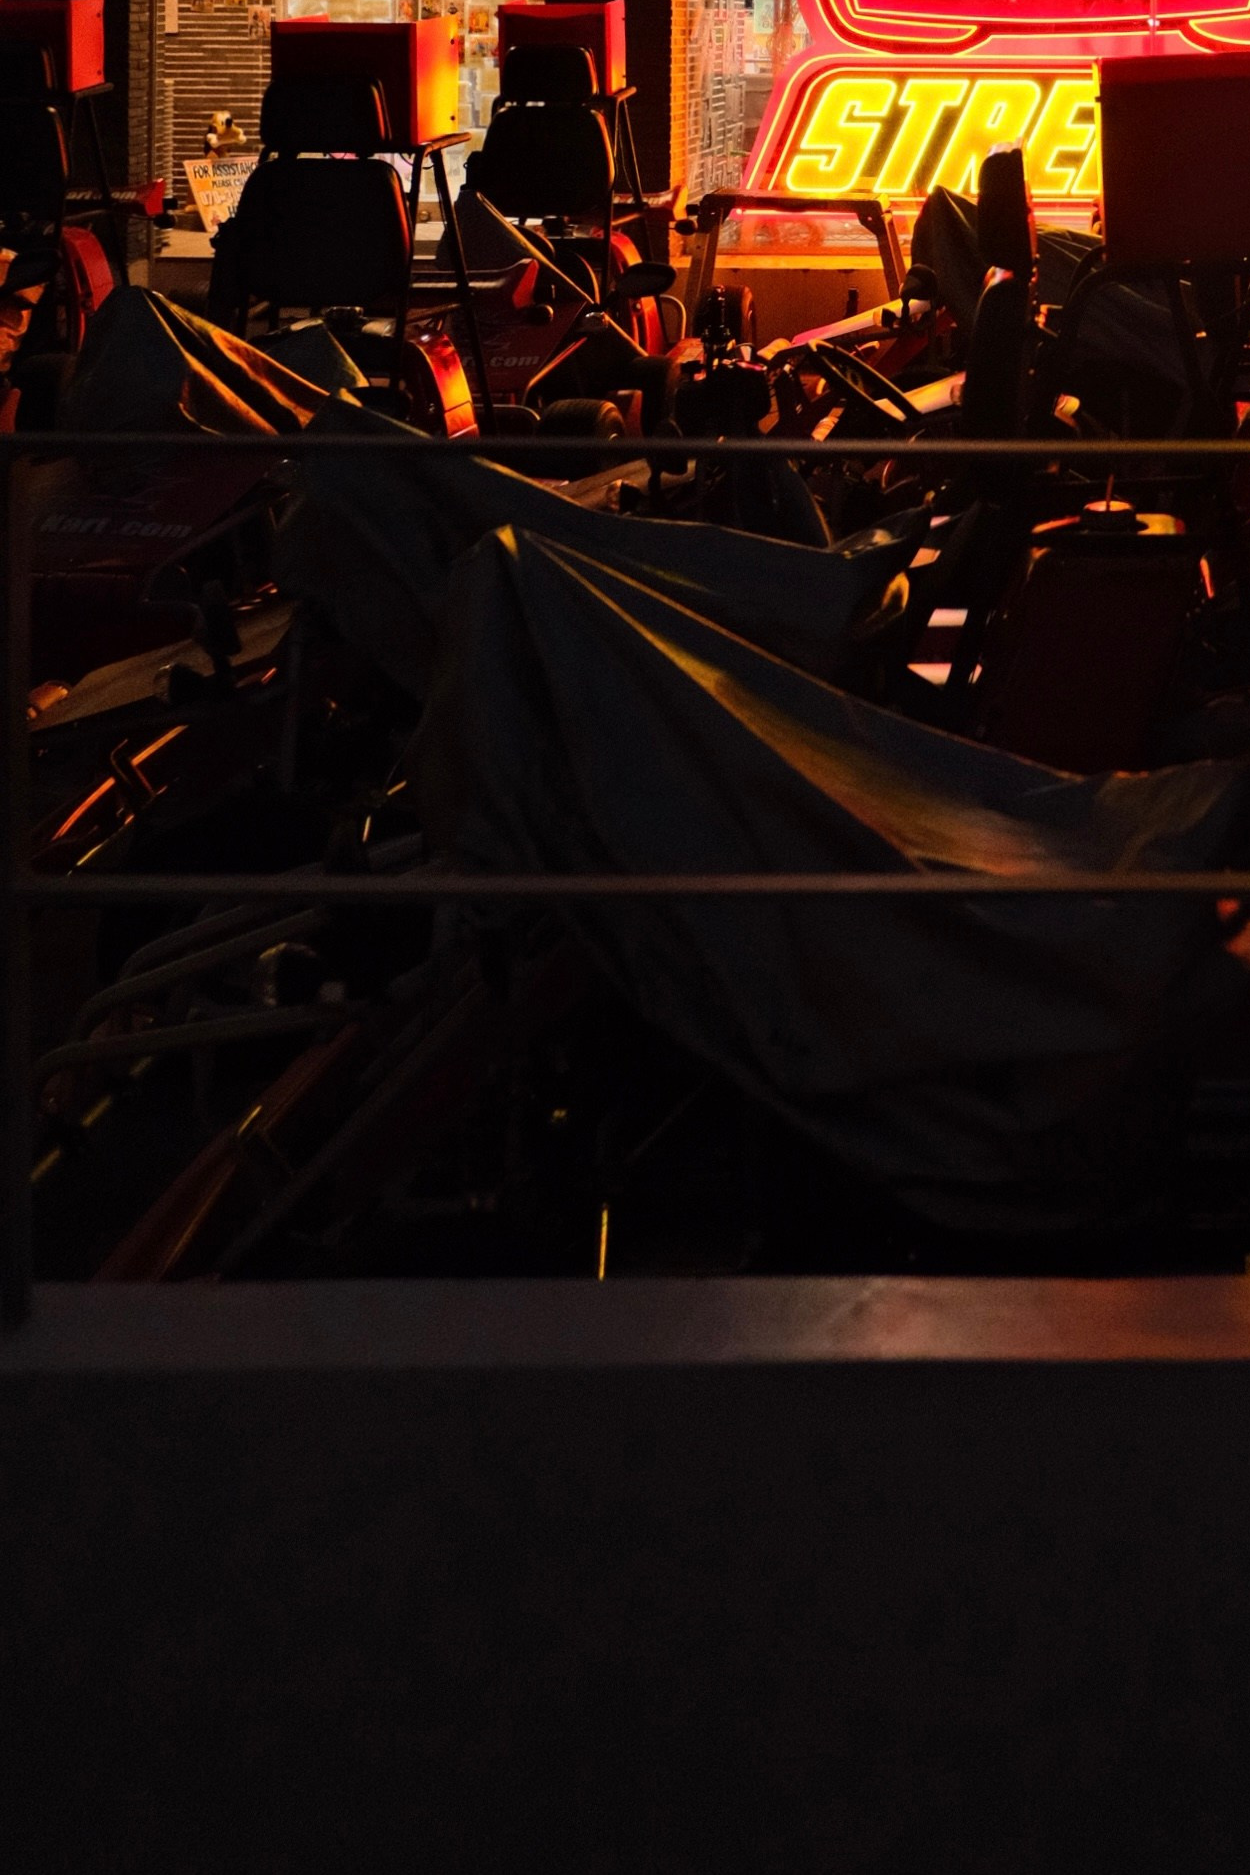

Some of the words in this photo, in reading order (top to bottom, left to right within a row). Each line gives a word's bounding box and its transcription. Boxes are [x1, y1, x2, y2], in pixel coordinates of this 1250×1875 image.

[786, 77, 1098, 195] STRE
[193, 165, 211, 179] FOR
[212, 161, 258, 177] ASSISTANC
[212, 179, 232, 188] PLEASE
